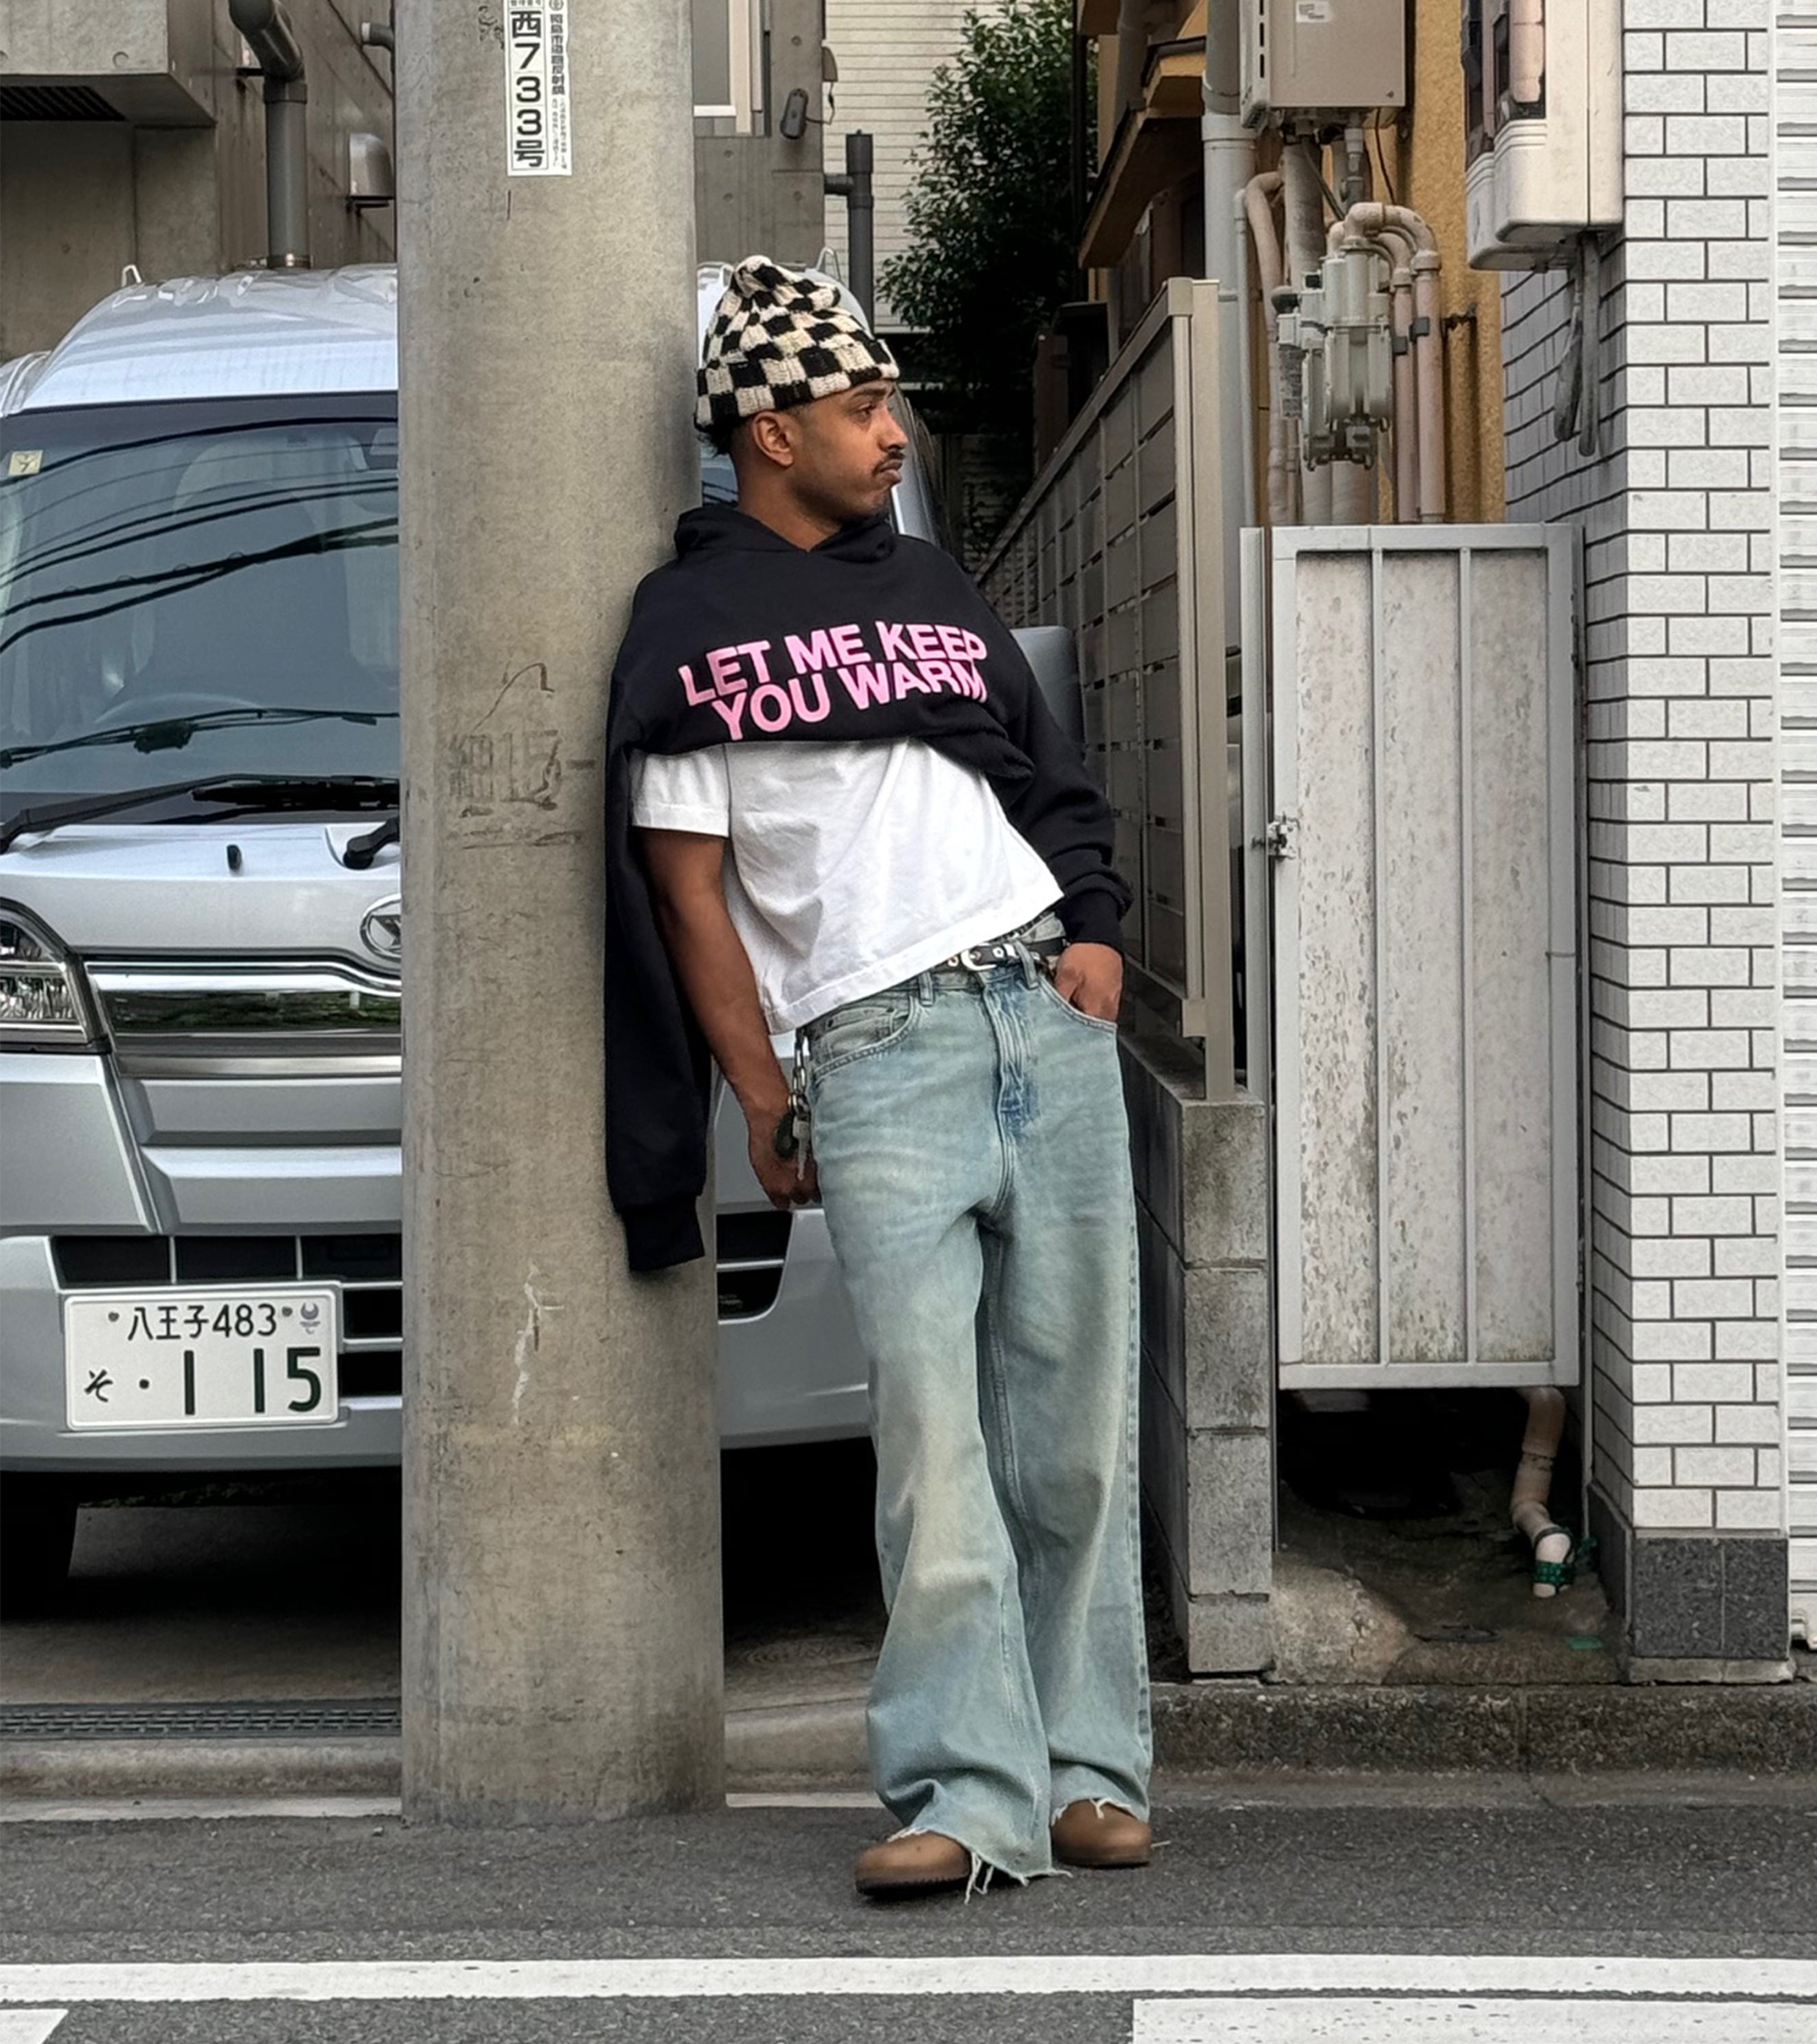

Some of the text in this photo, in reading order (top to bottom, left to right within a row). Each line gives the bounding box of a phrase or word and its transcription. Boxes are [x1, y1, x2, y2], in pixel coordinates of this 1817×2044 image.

[510, 10, 545, 168] 西733号
[678, 620, 987, 706] LET ME KEEP
[711, 660, 988, 741] YOU WARM
